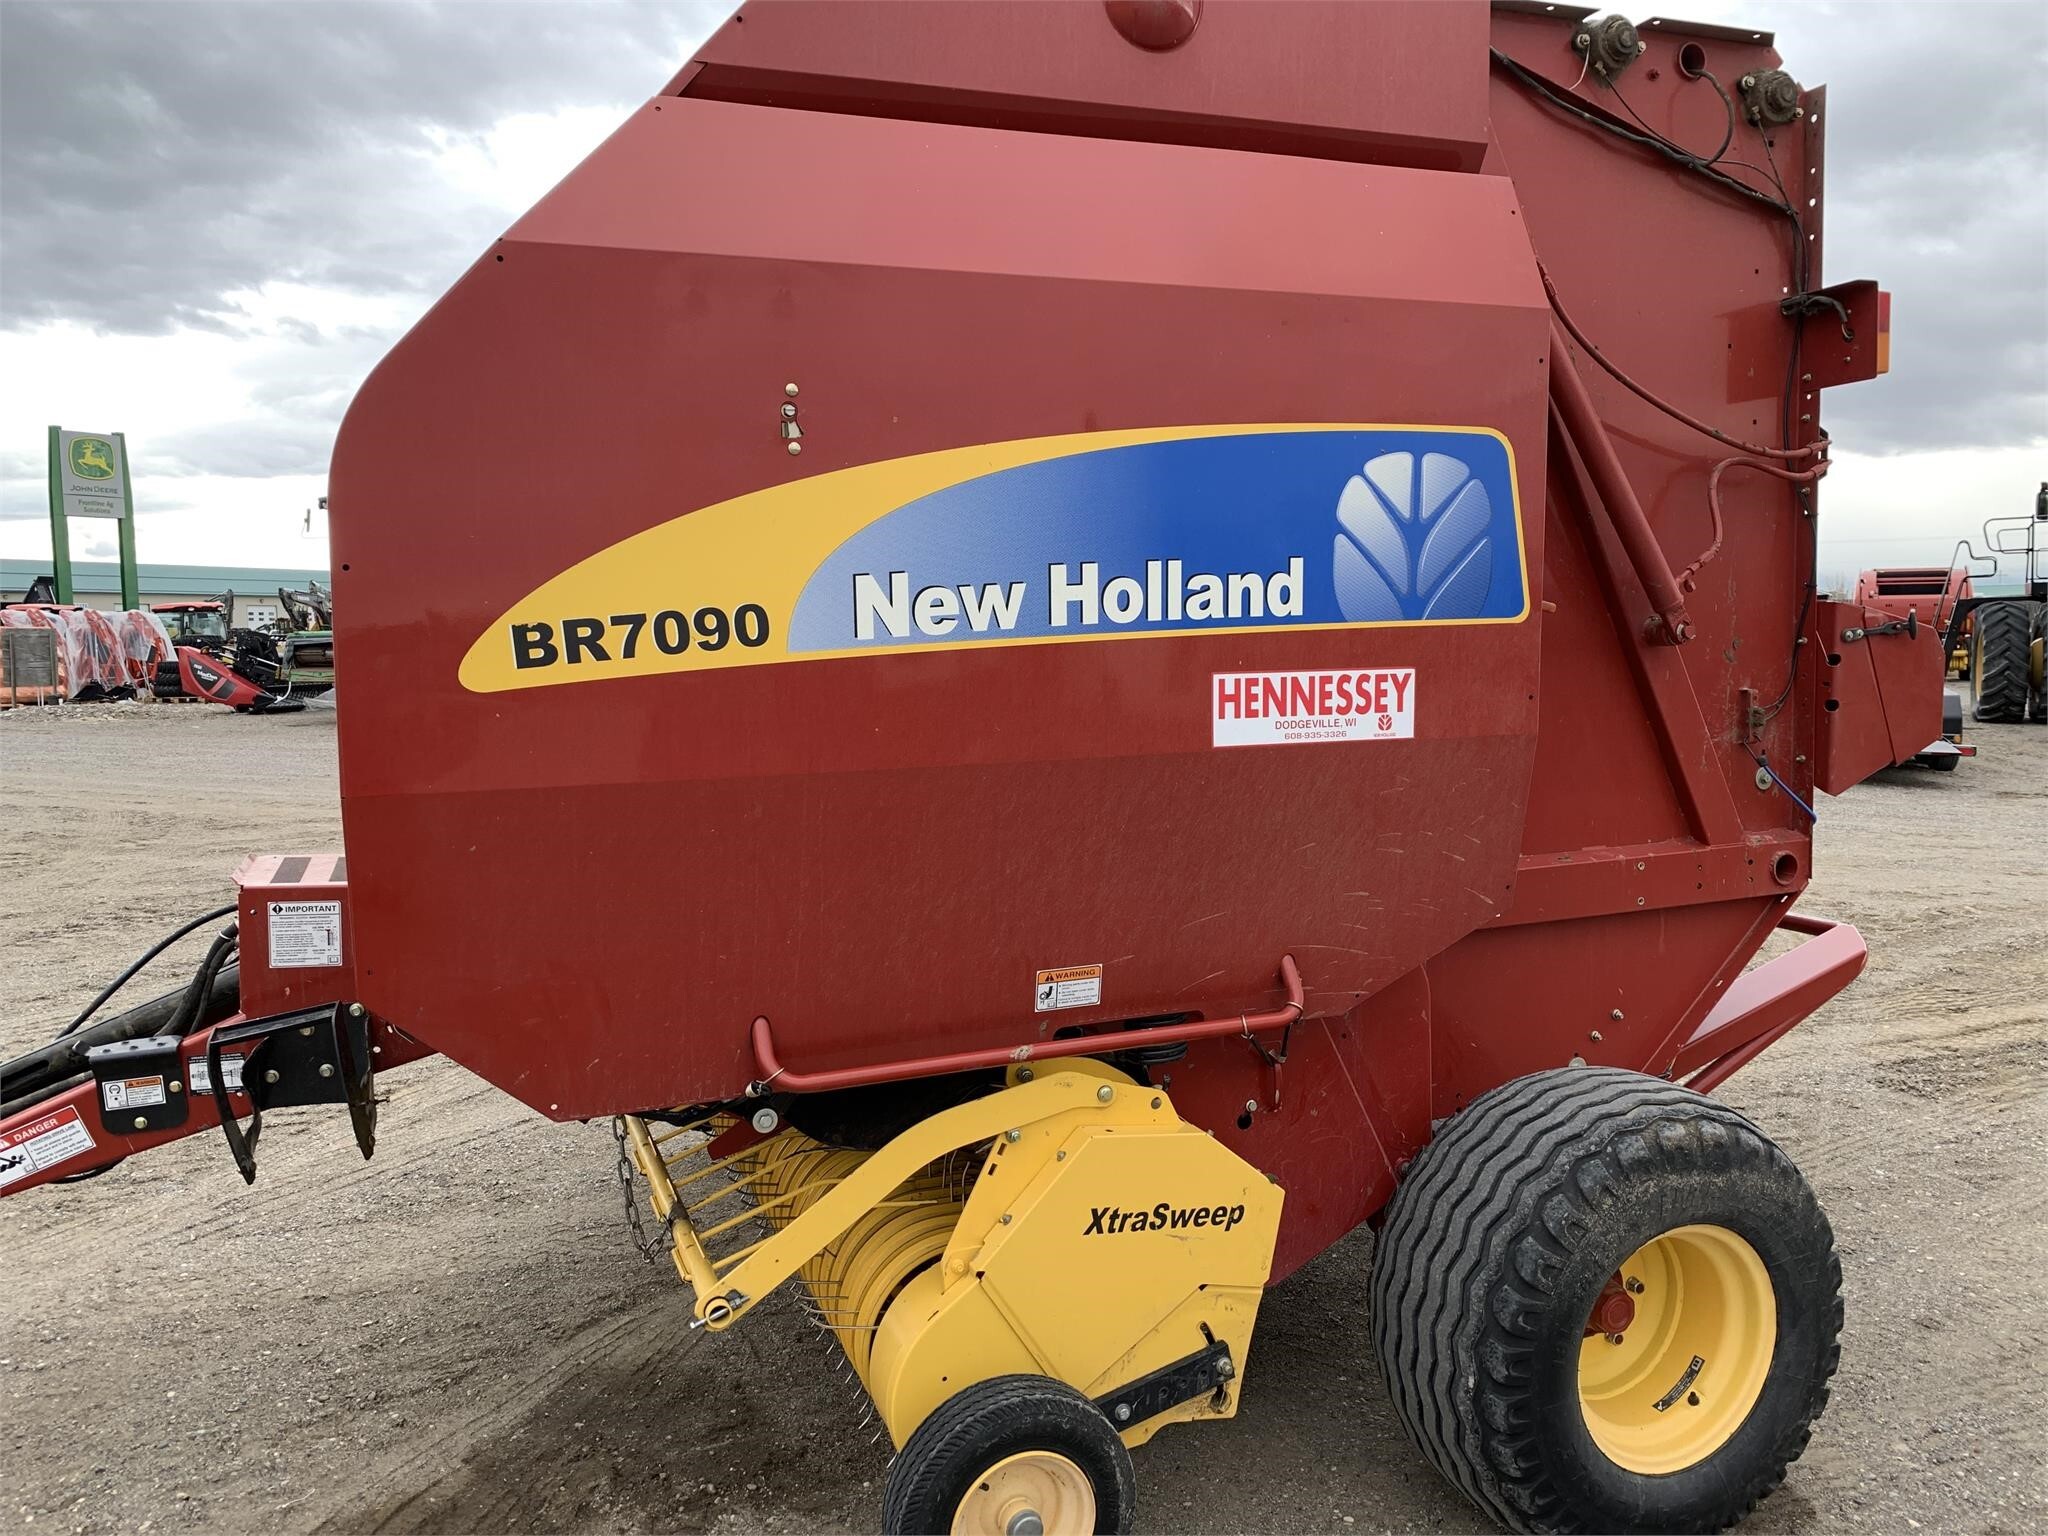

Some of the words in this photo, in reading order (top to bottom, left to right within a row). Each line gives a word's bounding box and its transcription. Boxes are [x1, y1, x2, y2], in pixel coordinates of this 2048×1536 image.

[853, 570, 1026, 640] New
[1048, 556, 1303, 627] Holland
[509, 603, 770, 669] BR7090
[1218, 673, 1412, 720] HENNESSEY
[1275, 719, 1343, 730] DODGEVILLE,
[1345, 718, 1357, 728] WI
[1284, 731, 1347, 740] 608-935-3326
[285, 905, 337, 913] IMPORTANT
[1055, 969, 1096, 980] WARNING
[13, 1118, 59, 1142] DANGER
[1083, 1203, 1245, 1236] XtraSweep
